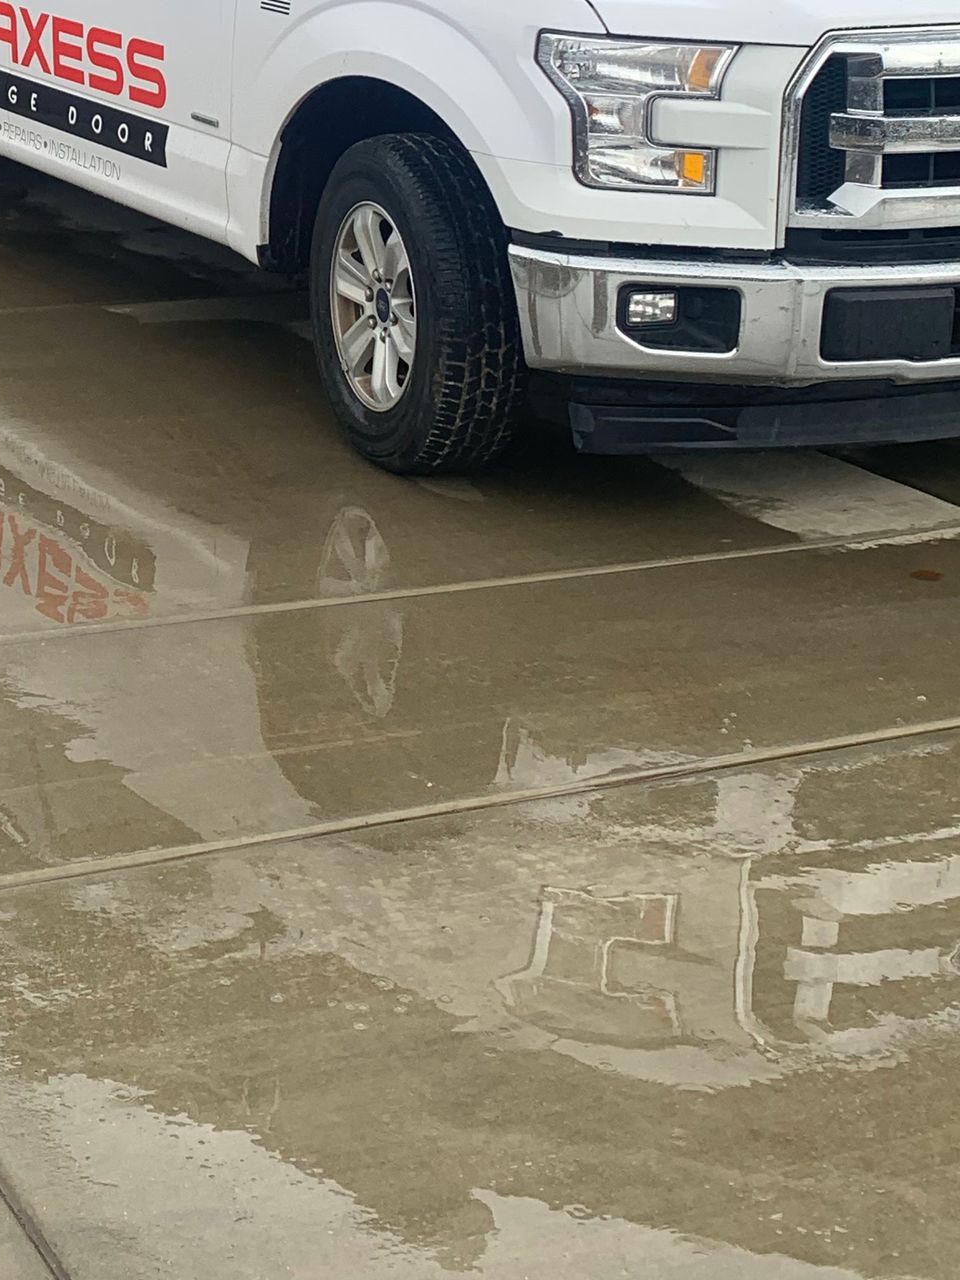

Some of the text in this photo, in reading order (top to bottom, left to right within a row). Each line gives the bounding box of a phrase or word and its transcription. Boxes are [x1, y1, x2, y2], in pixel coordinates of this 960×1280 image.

[2, 121, 43, 150] REPAIRS
[48, 138, 121, 181] INSTALLATION
[68, 105, 152, 153] DOOR
